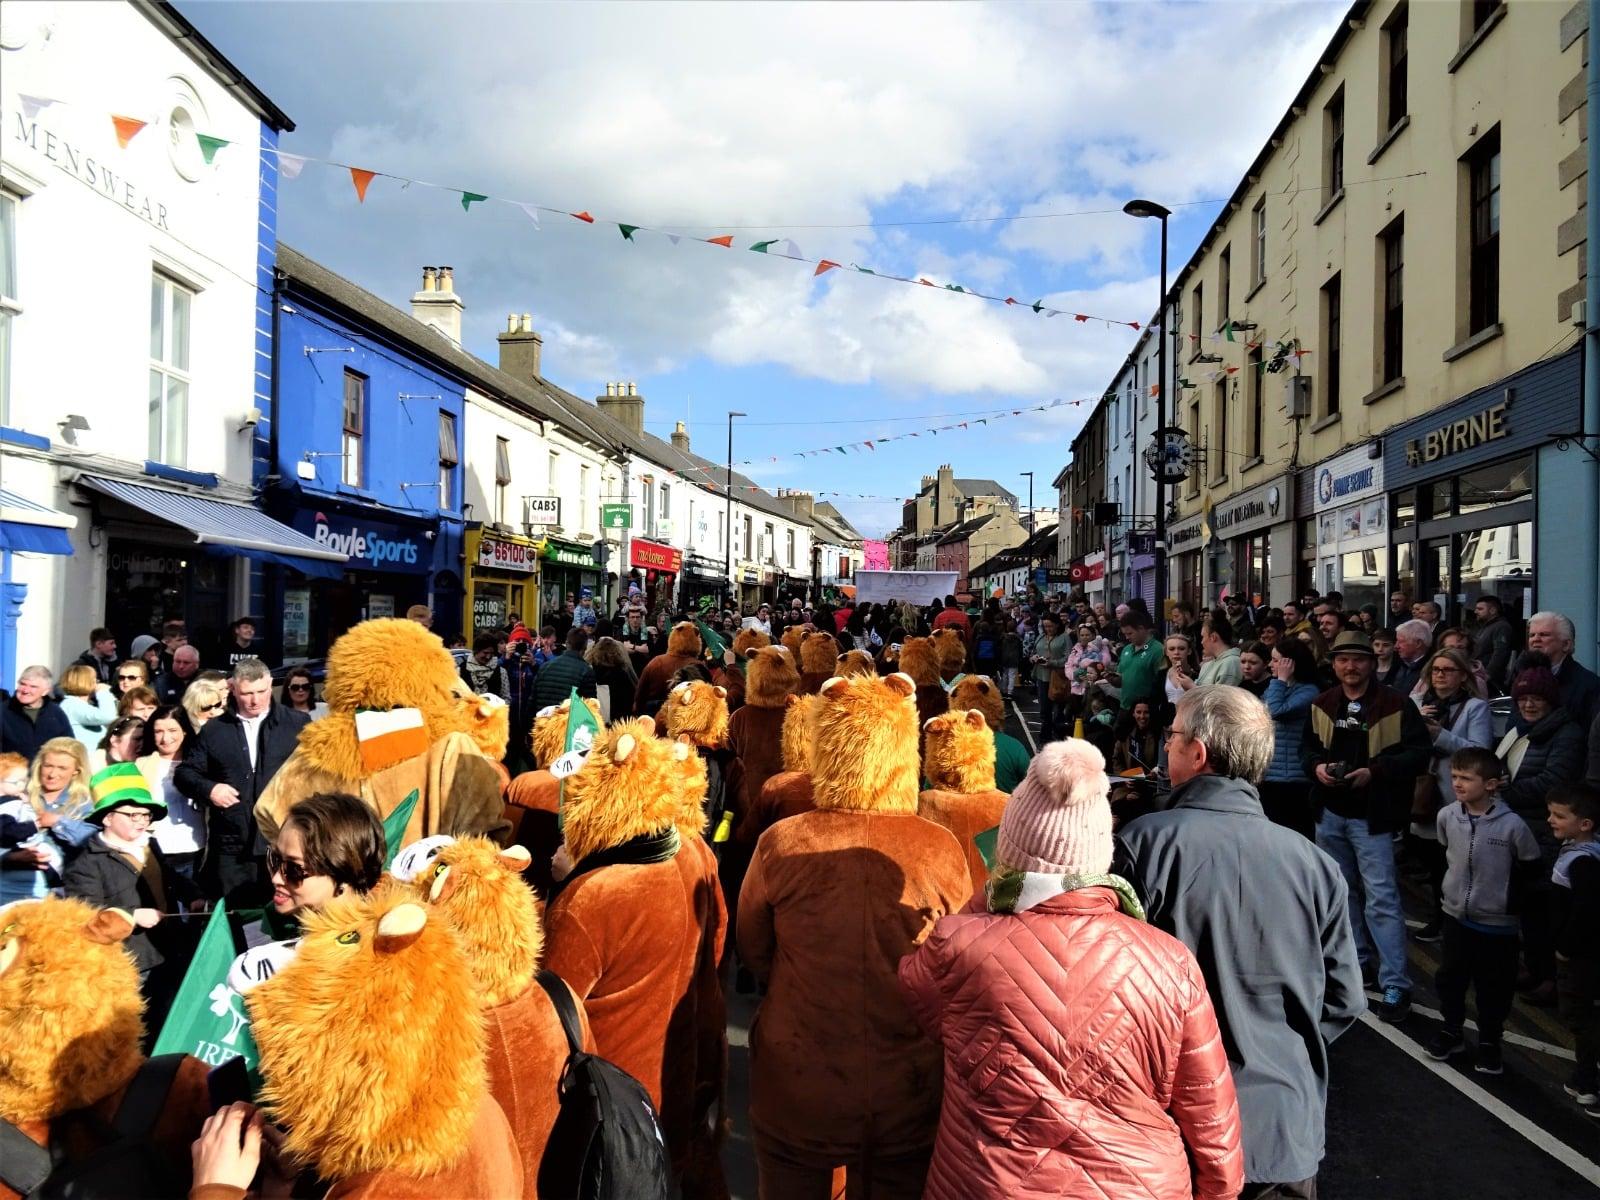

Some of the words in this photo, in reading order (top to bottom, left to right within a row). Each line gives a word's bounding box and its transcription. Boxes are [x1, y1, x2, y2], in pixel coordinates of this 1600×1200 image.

[15, 112, 169, 231] MENSWEAR
[531, 500, 557, 512] CABS
[314, 523, 418, 567] BoyleSports
[494, 541, 525, 563] 66100
[474, 600, 498, 613] 66100
[474, 615, 497, 627] CABS
